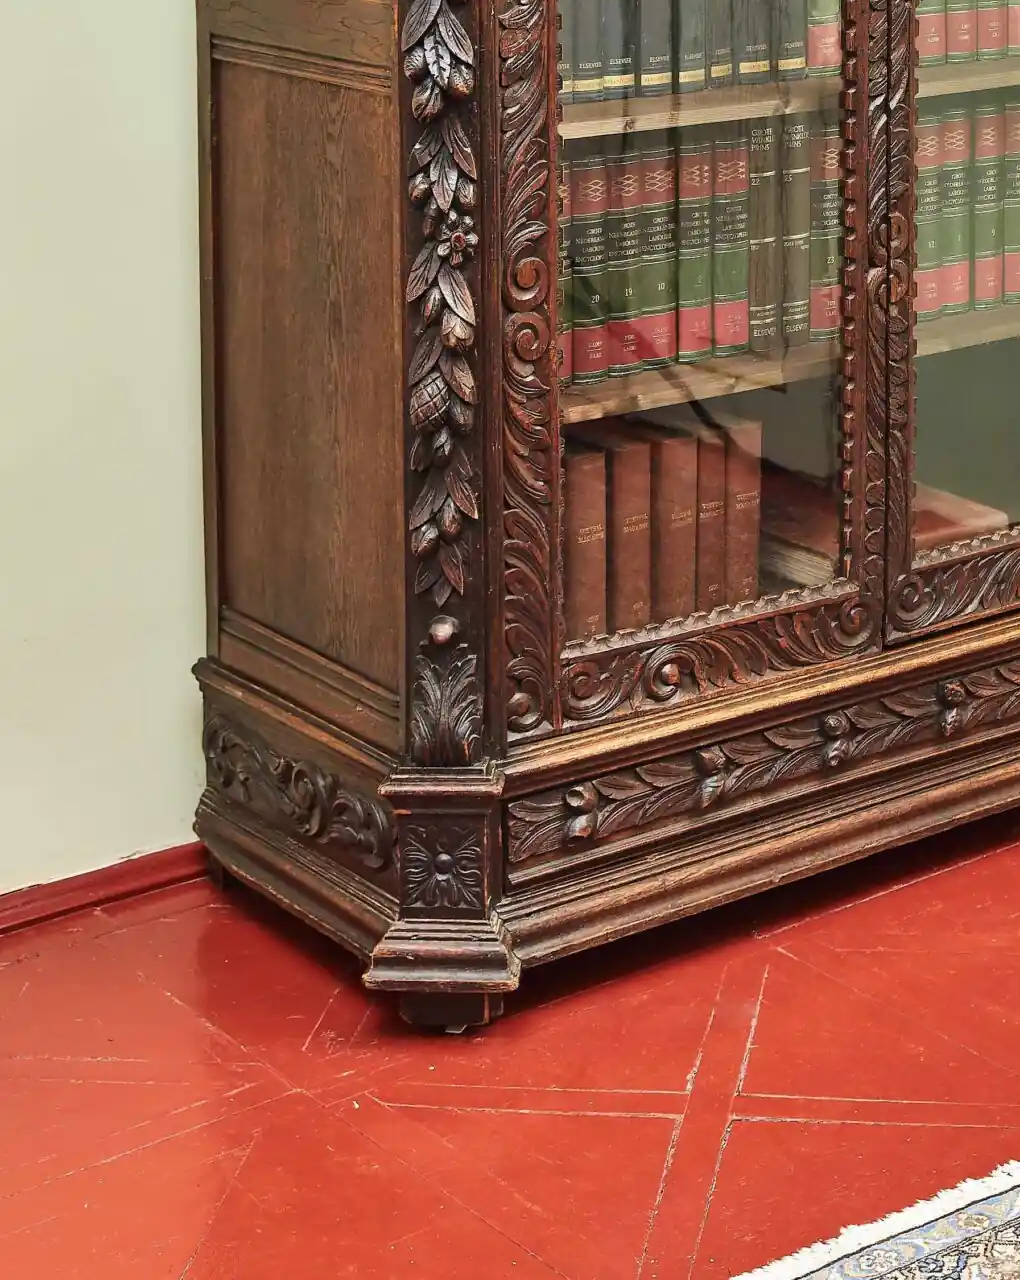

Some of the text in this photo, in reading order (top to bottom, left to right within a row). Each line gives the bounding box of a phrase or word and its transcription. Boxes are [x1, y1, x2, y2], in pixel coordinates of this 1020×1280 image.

[658, 282, 666, 291] 10
[625, 287, 633, 296] 19
[591, 294, 600, 303] 20
